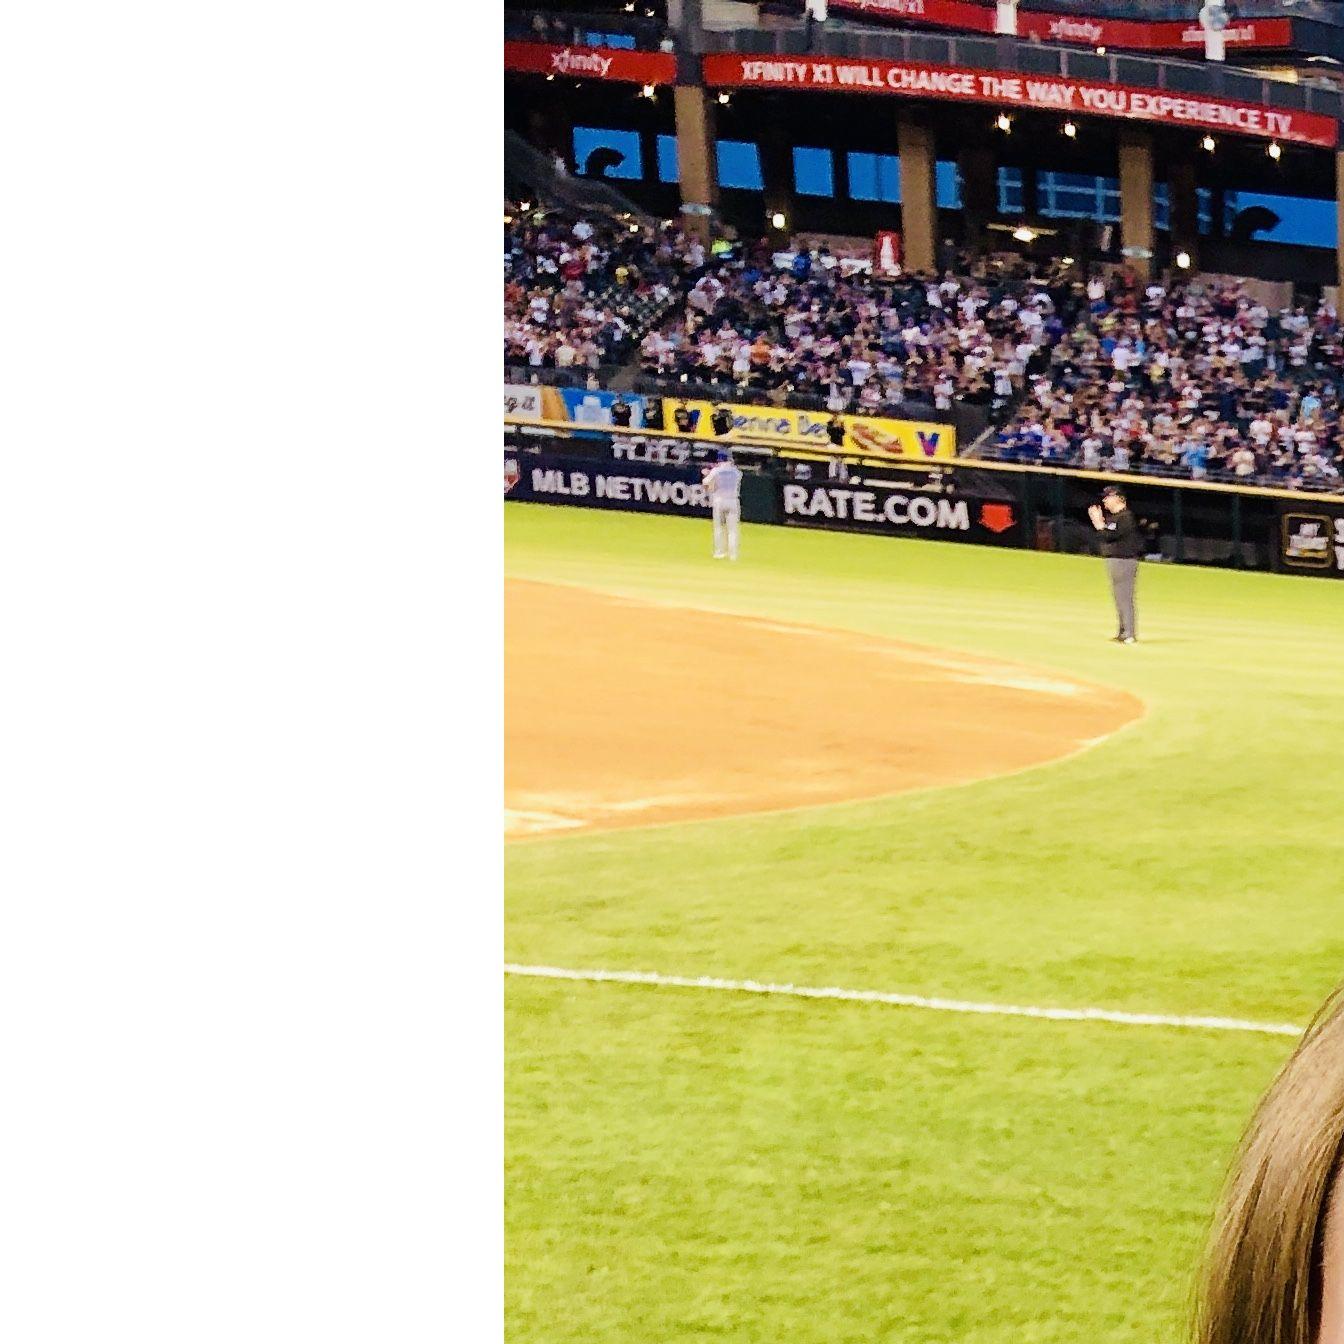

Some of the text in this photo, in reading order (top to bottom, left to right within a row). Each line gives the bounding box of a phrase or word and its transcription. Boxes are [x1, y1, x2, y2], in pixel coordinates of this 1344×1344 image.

[742, 61, 807, 82] XFINITY
[837, 65, 884, 87] WILL
[887, 67, 975, 95] CHANGE
[979, 76, 1021, 99] THE
[1026, 81, 1075, 104] WAY
[1079, 86, 1126, 110] YOU
[1130, 93, 1263, 129] EXPERIENCE
[1264, 111, 1293, 133] TV
[532, 468, 712, 507] MLB NETWOR
[783, 484, 970, 530] RATE.COM
